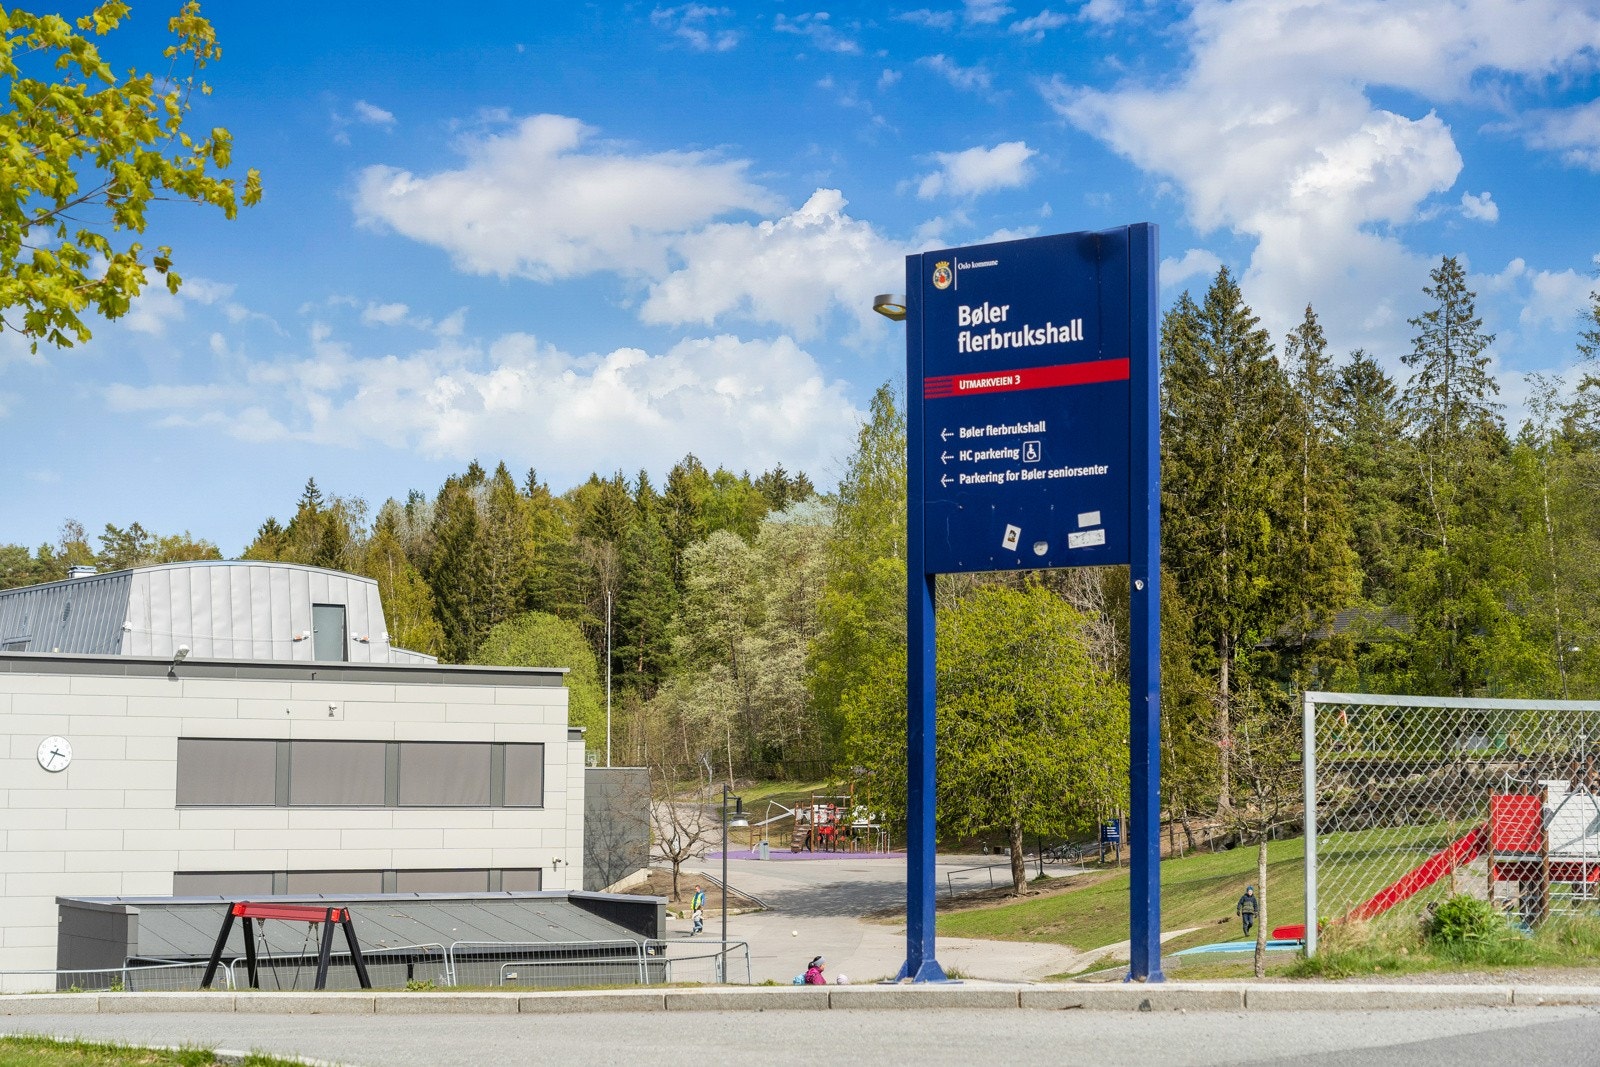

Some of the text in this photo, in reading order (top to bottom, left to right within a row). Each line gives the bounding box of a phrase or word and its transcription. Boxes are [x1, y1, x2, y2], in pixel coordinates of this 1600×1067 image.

[958, 259, 998, 270] Oslo kommune
[958, 302, 1009, 327] Bøler
[958, 318, 1083, 353] flerbrukshall
[959, 375, 1021, 390] UTMARKVEIEN 3
[959, 421, 1046, 439] Bøler flerbrukshall
[959, 447, 1020, 462] HC parkering
[959, 465, 1109, 485] Parkering for Bøler seniorsenter
